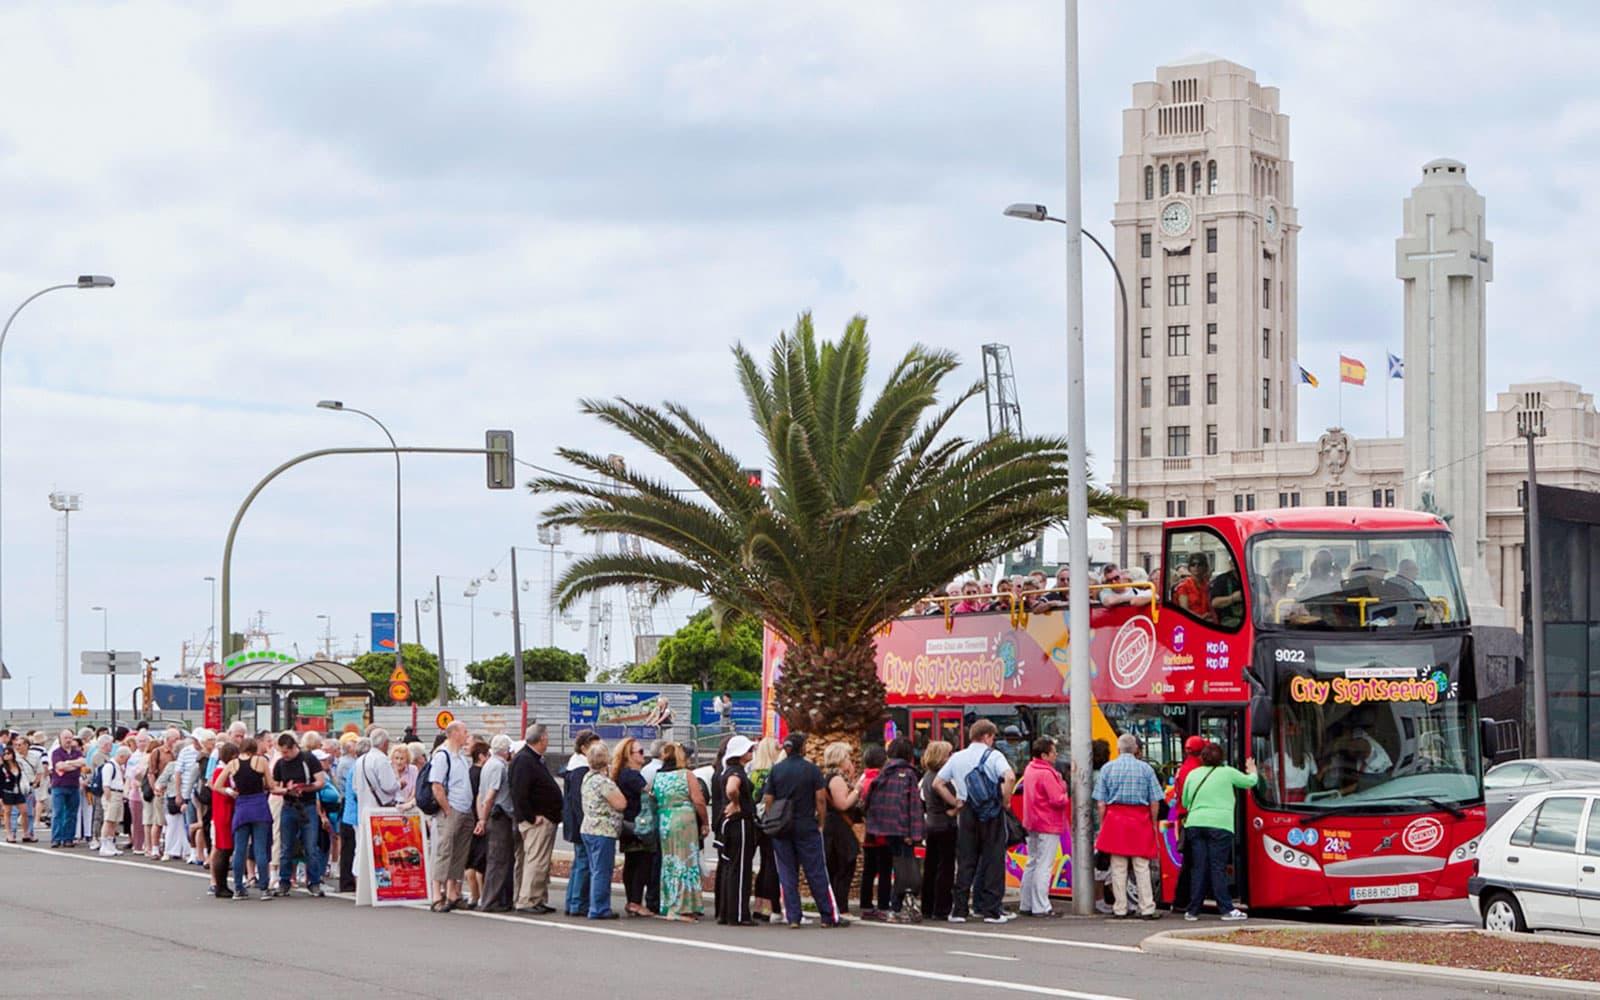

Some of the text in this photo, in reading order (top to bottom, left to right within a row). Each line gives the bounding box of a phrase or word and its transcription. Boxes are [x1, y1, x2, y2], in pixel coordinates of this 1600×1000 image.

[1206, 640, 1229, 655] Hop On
[1275, 649, 1305, 662] 9022
[1206, 657, 1219, 670] Hop
[883, 652, 1005, 698] City Sightseeing
[1391, 668, 1416, 676] Tenerife
[1291, 676, 1438, 705] City Sightseeing
[1324, 837, 1339, 852] 24
[1356, 889, 1378, 899] 6688
[1380, 887, 1397, 897] HCJ
